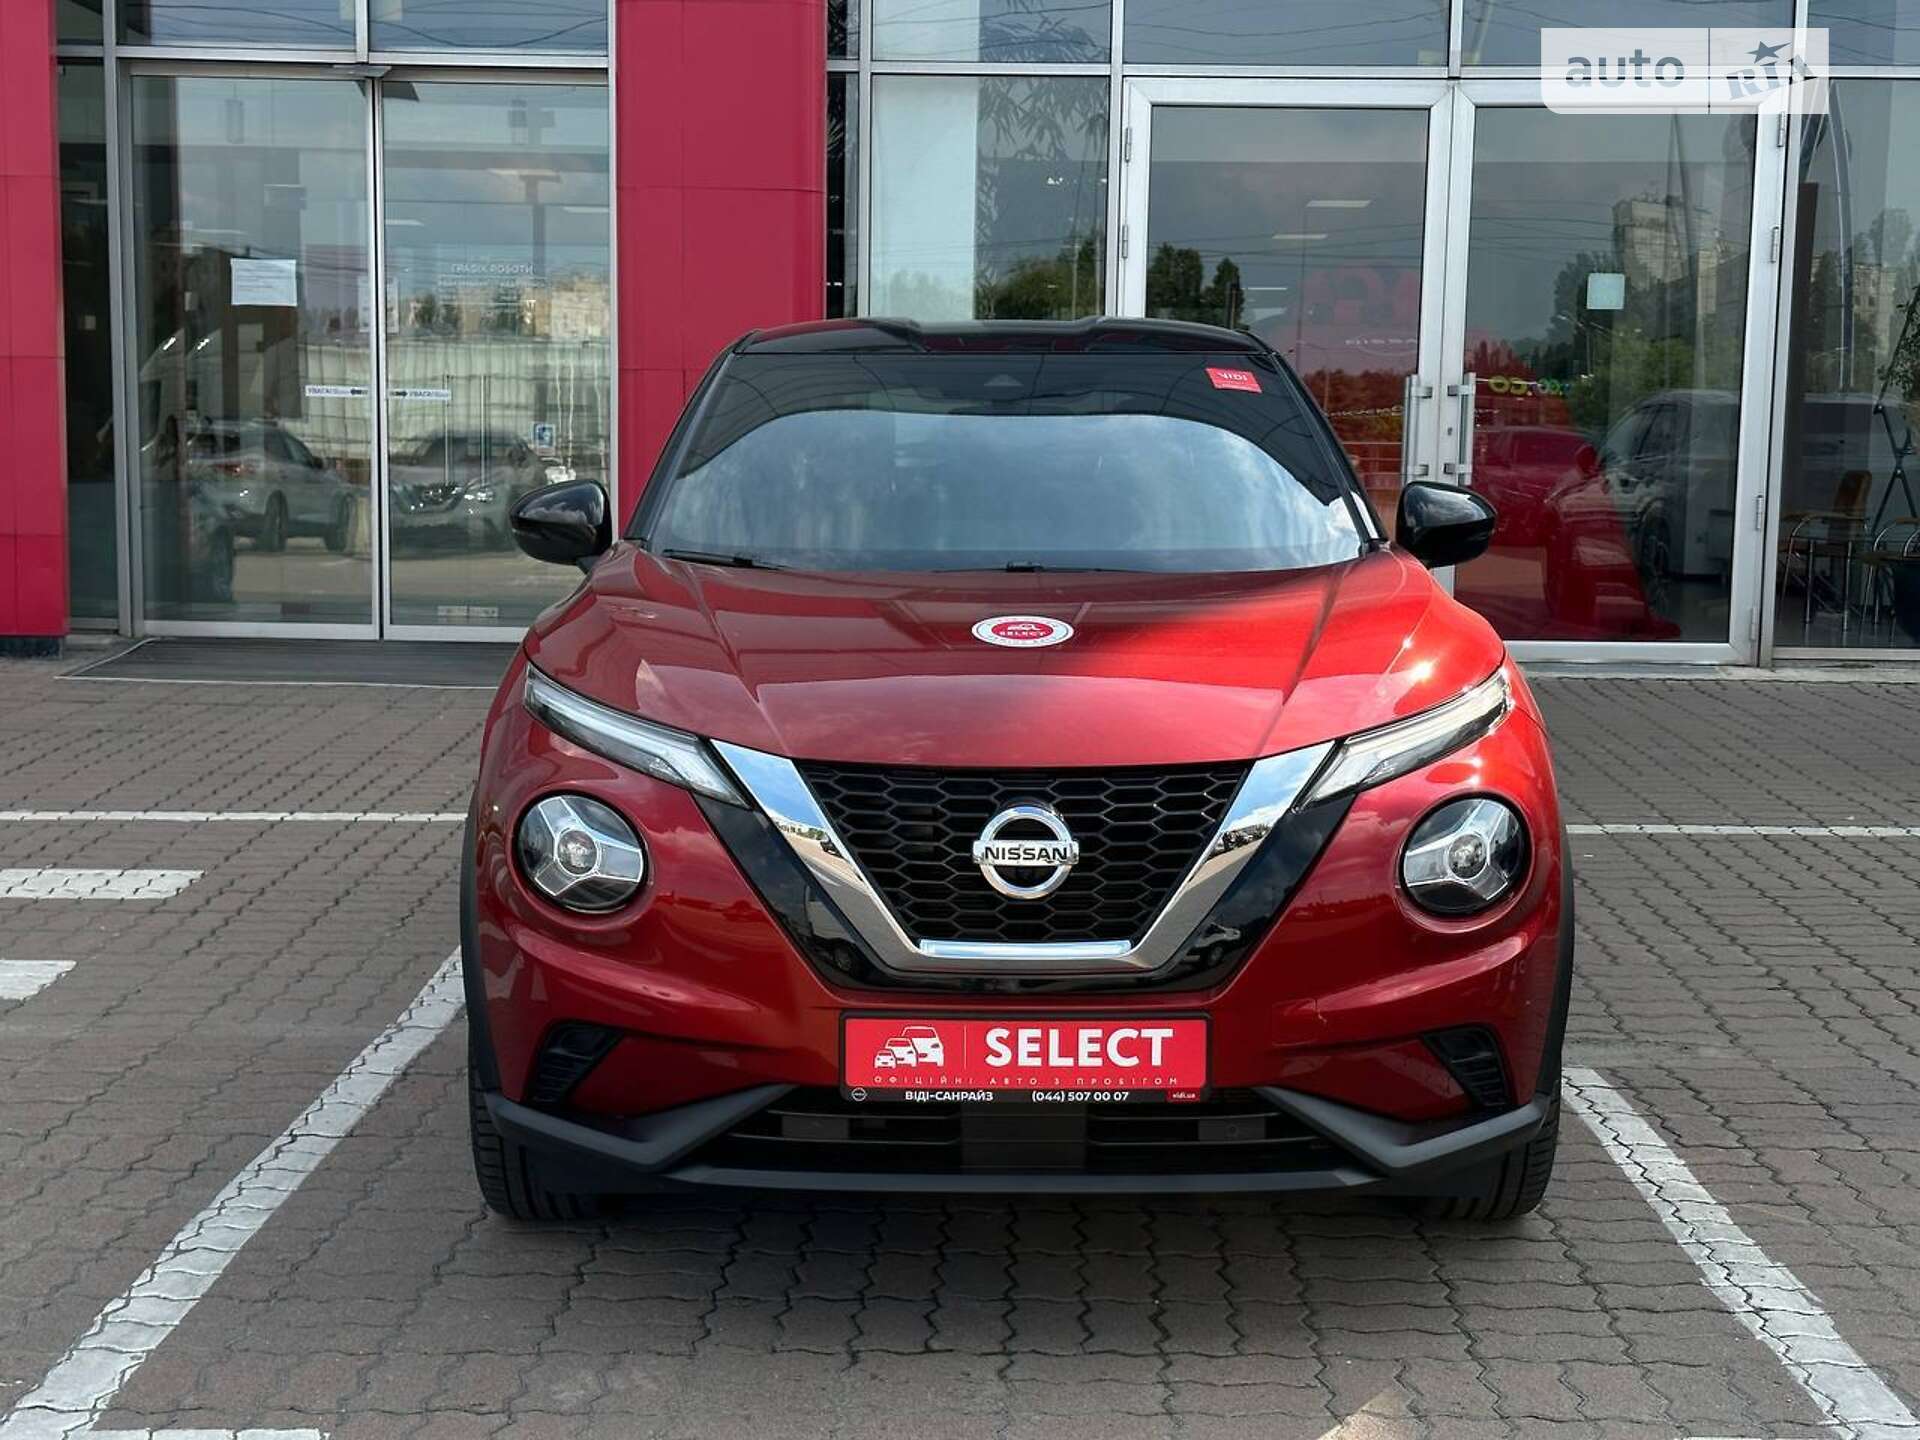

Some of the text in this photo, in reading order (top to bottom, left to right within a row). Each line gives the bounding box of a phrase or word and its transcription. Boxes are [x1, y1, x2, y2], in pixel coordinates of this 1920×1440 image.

[985, 846, 1068, 861] NISSAN
[985, 1027, 1174, 1068] SELECT
[873, 1074, 974, 1086] ОФІЦІЙНІ
[989, 1076, 1038, 1086] АВТО
[1076, 1077, 1178, 1086] ПРОБІГОМ
[905, 1089, 994, 1102] ВІДІ-САНРАЙЗ
[1031, 1090, 1130, 1102] (044) 507 00 07
